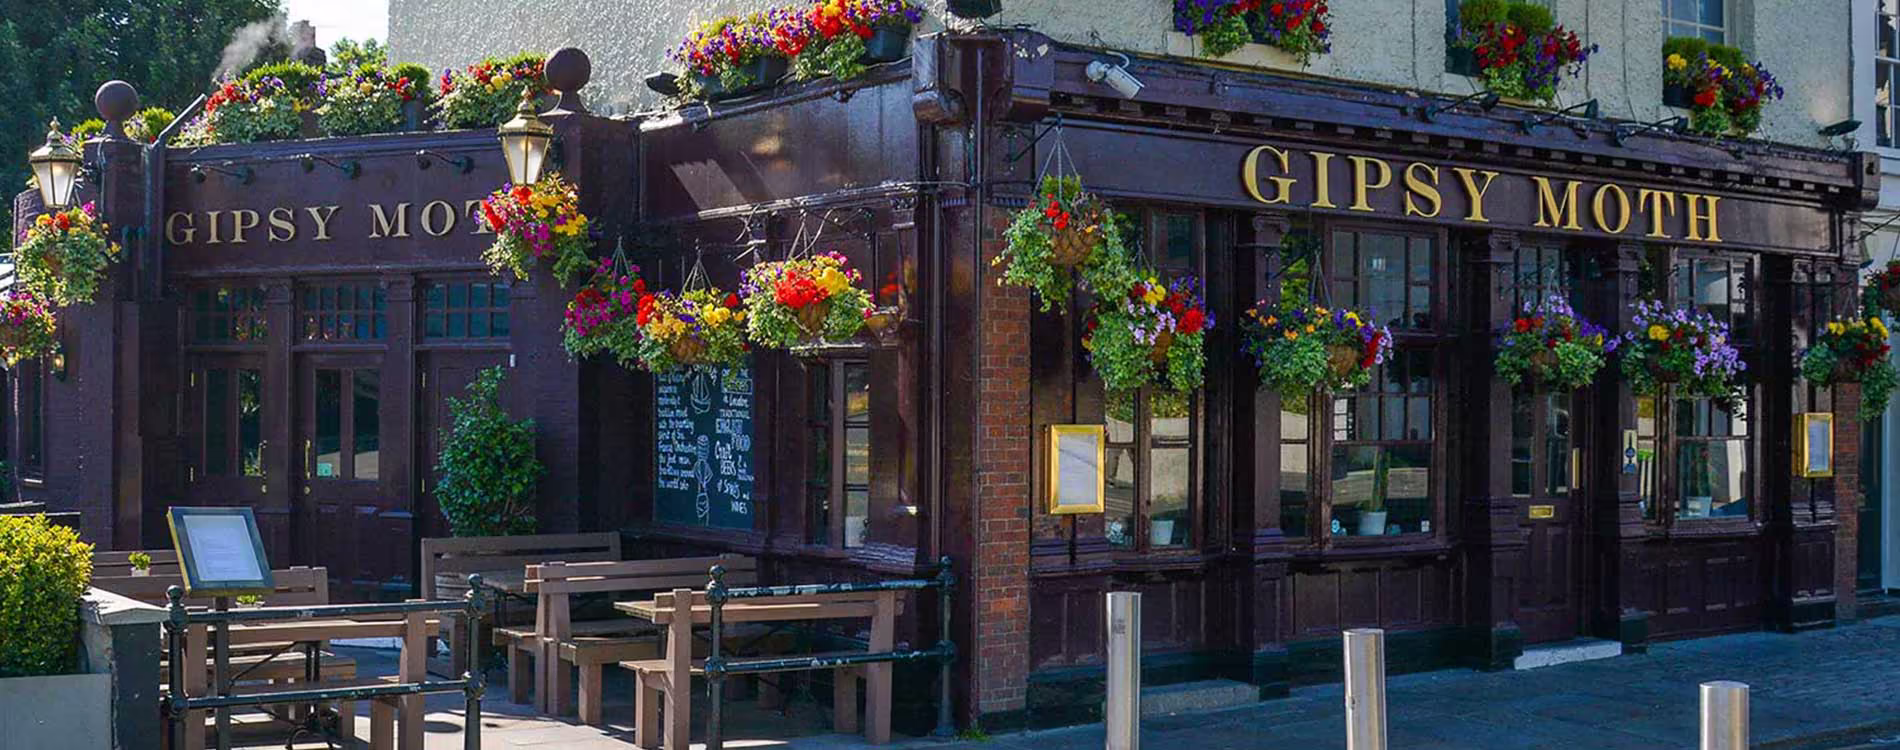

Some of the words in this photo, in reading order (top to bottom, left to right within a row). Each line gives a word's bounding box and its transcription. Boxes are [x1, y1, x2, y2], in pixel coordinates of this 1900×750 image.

[166, 204, 339, 245] GIPSY
[368, 200, 496, 239] MOT
[1243, 145, 1500, 222] GIPSY
[1532, 176, 1722, 243] MOTH
